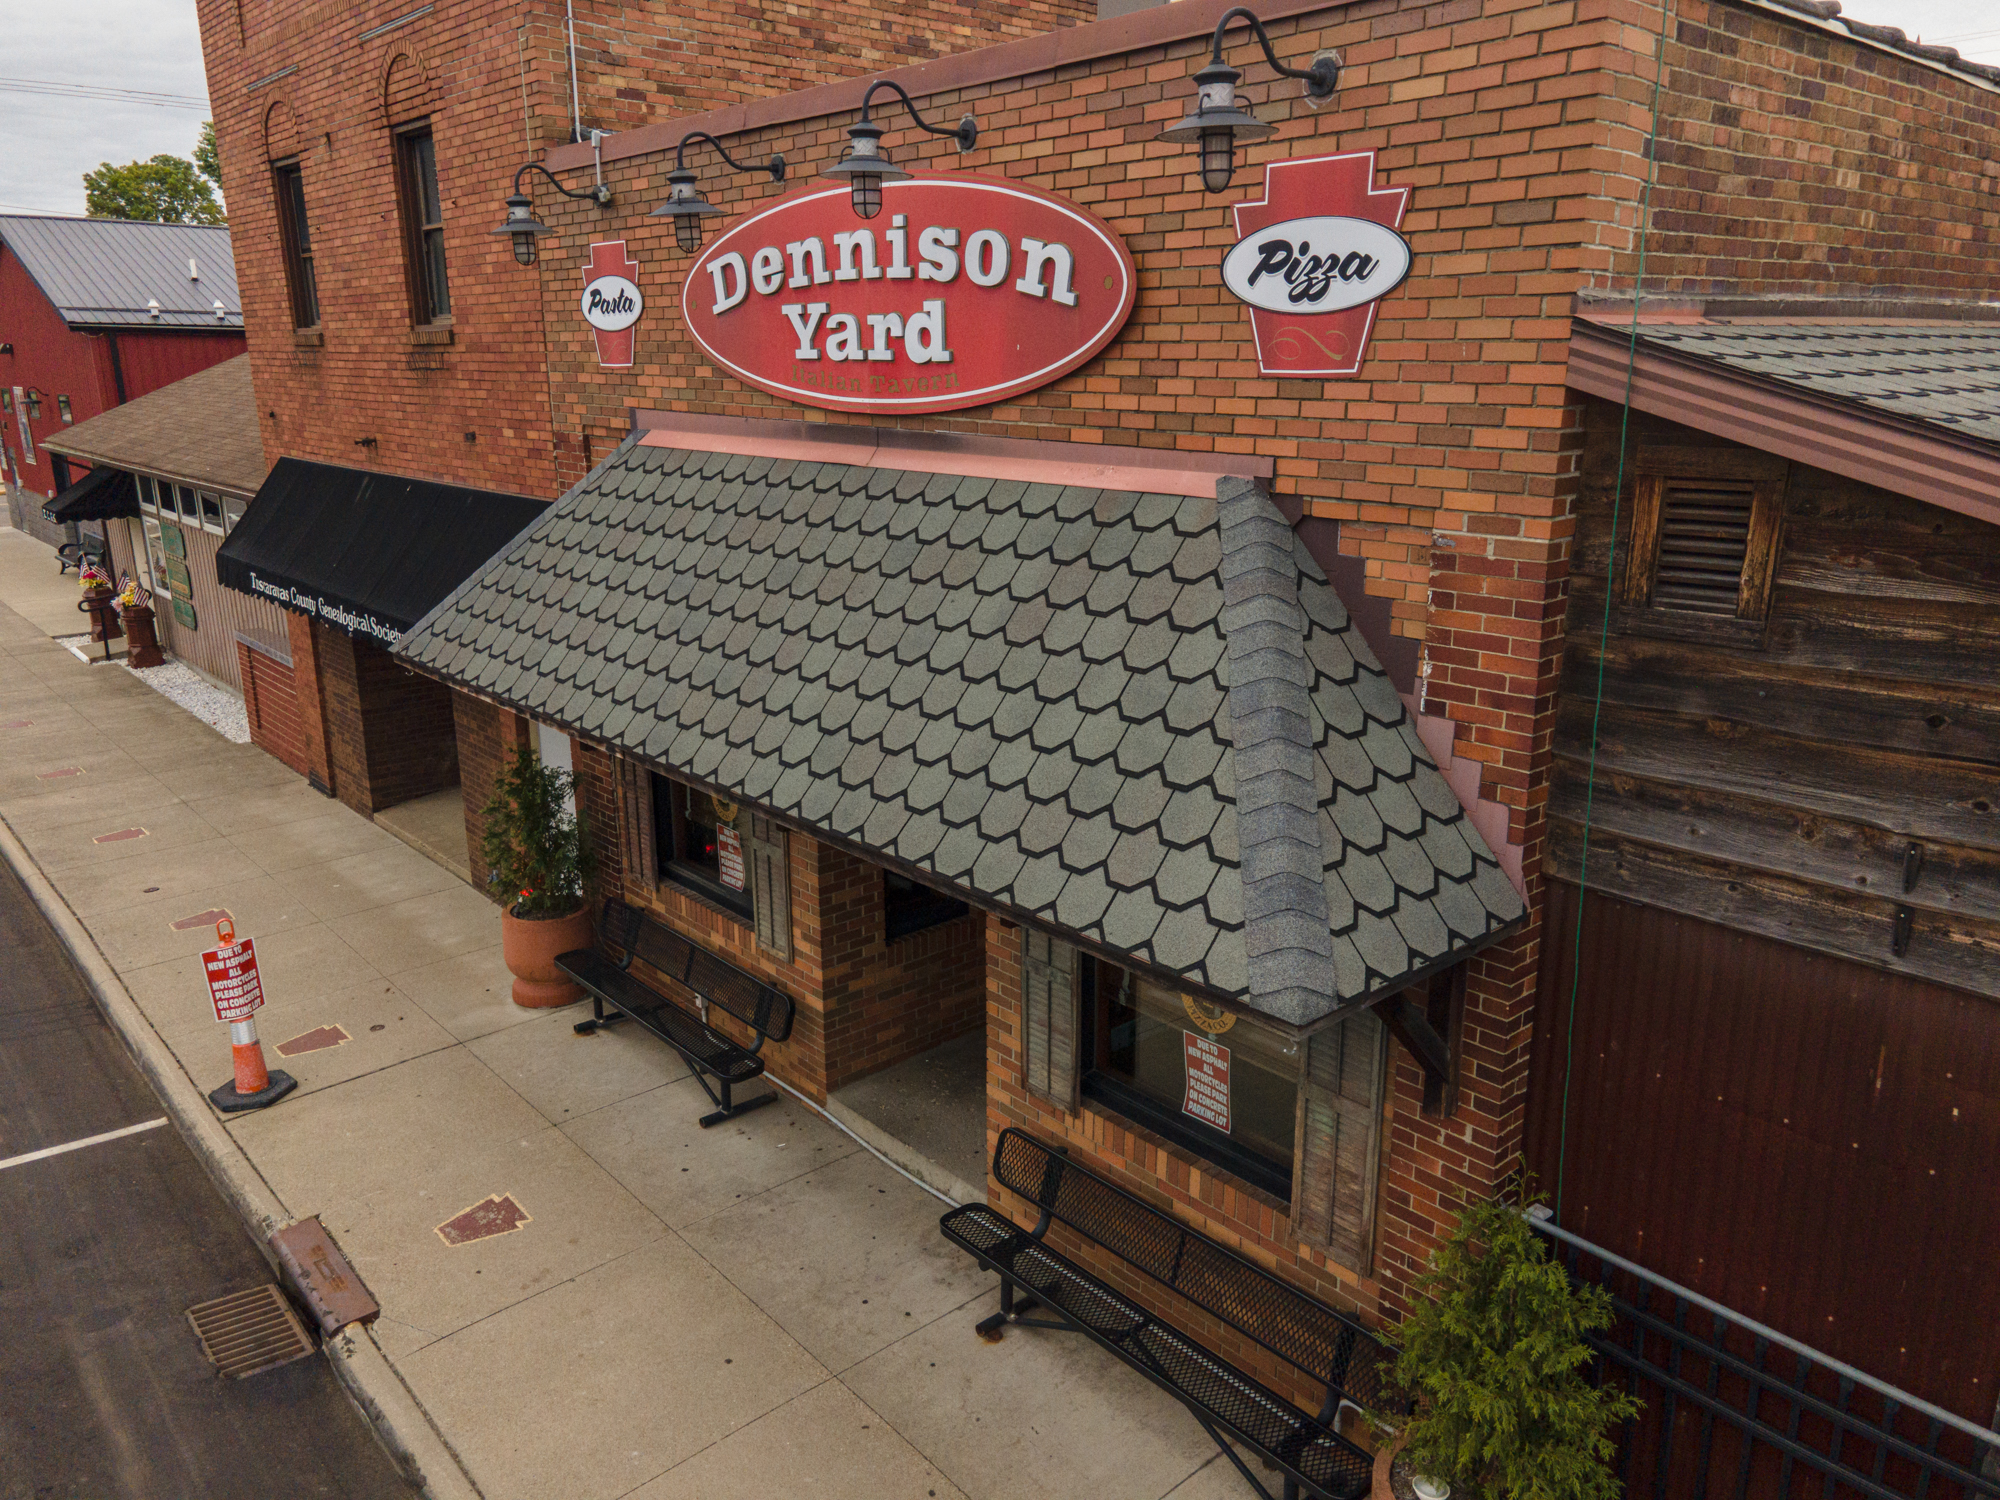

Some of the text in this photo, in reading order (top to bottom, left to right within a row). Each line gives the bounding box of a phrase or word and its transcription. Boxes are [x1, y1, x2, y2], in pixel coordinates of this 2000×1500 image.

[706, 214, 1079, 317] Dennison
[1247, 239, 1380, 304] Pizza
[587, 287, 636, 316] Pasta
[782, 299, 954, 364] Yard
[791, 365, 960, 393] Italian Tavern
[290, 586, 317, 616] County
[318, 597, 371, 632] Genealogical
[207, 949, 253, 971] NEW ASPHALT
[217, 945, 242, 960] DUE TO
[211, 968, 257, 990] MOTORCYCLES
[229, 967, 242, 977] ALL
[214, 978, 259, 1000] PLEASE PARK
[217, 988, 261, 1009] ON CONCRETE
[220, 998, 261, 1018] PARKING LOT
[1188, 1045, 1228, 1072] NEW ASPHALT
[1197, 1038, 1218, 1056] DUE TO
[1188, 1066, 1228, 1094] MOTORCYCLES
[1203, 1063, 1214, 1076] ALL
[1189, 1077, 1228, 1105] PLEASE PARK
[1189, 1088, 1228, 1116] ON CONCRETE
[1187, 1100, 1228, 1127] PARKING LOT
